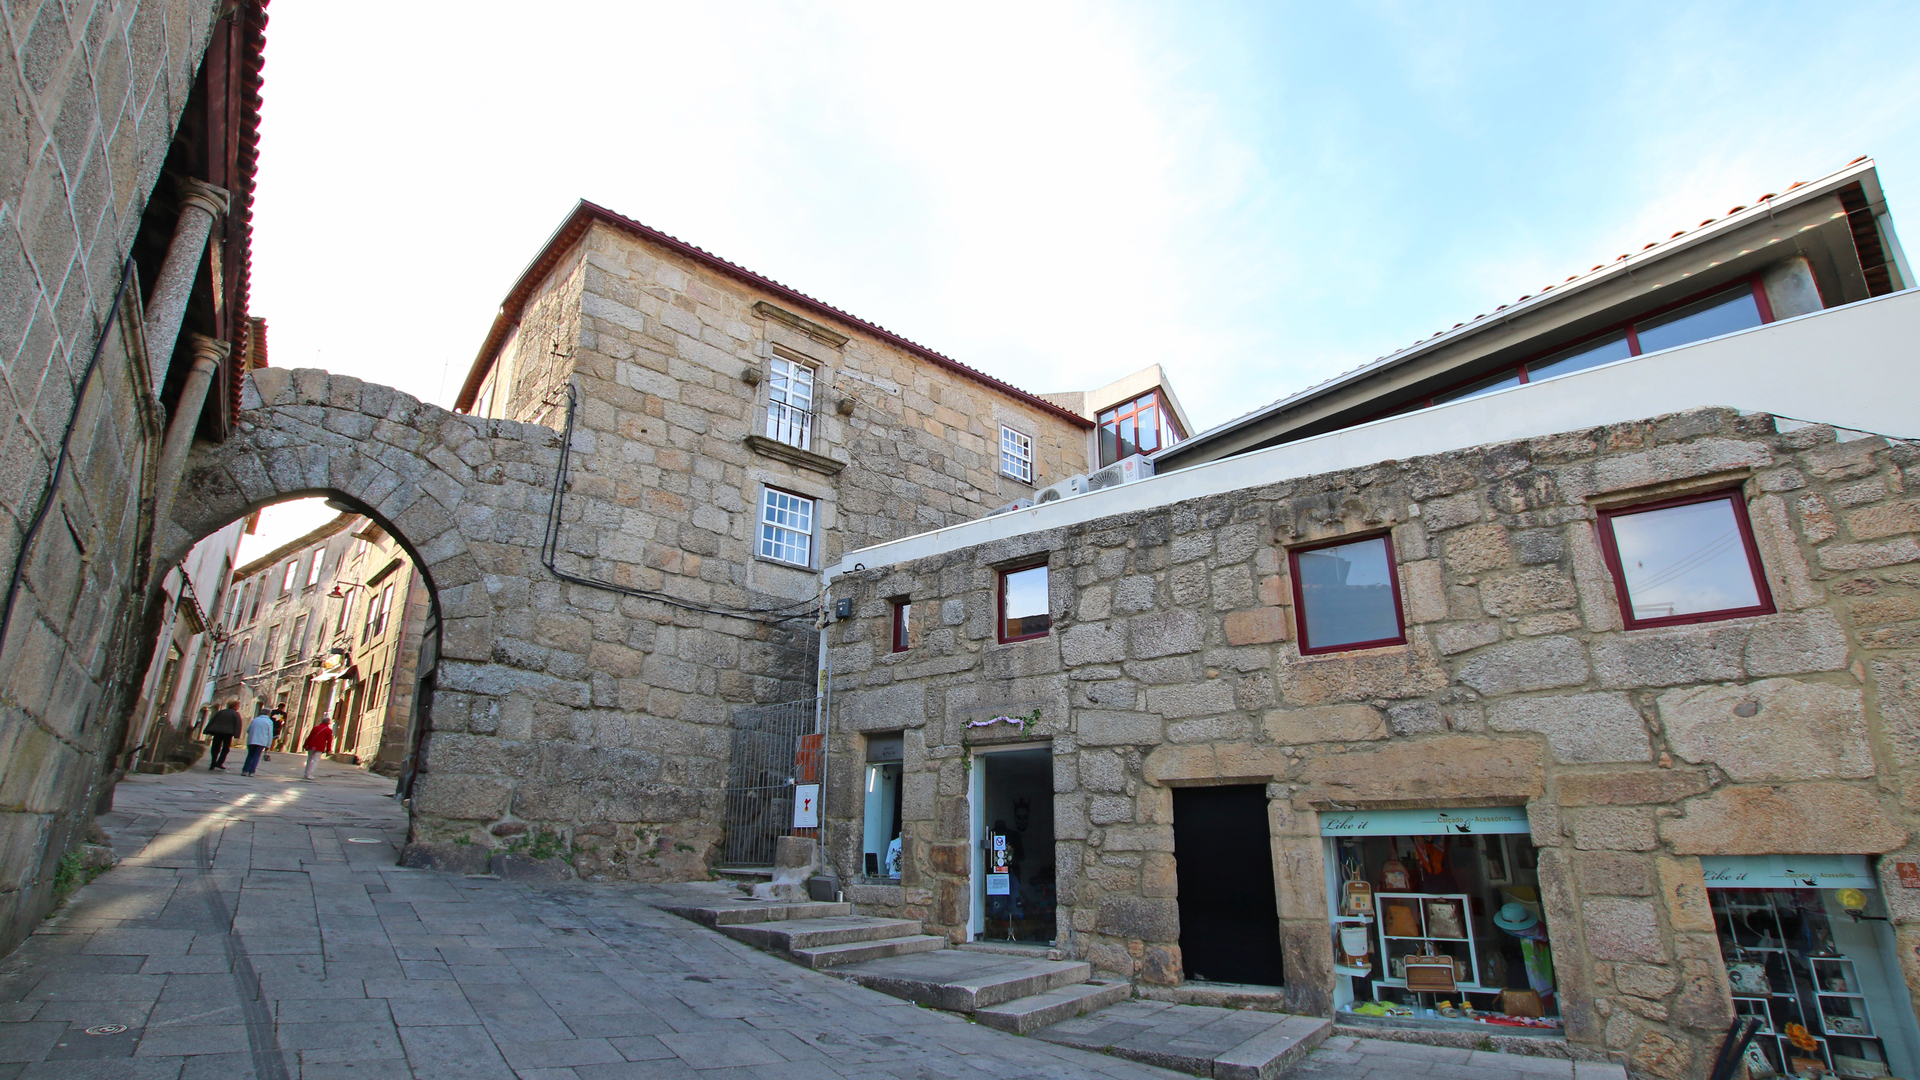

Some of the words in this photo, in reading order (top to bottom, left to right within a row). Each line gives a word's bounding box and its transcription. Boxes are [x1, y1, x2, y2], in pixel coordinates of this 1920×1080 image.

[1321, 815, 1354, 830] Like
[1357, 820, 1369, 830] it
[1437, 816, 1464, 824] Calçado
[1474, 815, 1512, 823] Acessórios
[1703, 866, 1731, 881] Like
[1735, 872, 1748, 881] it
[1820, 871, 1856, 879] Acessórios
